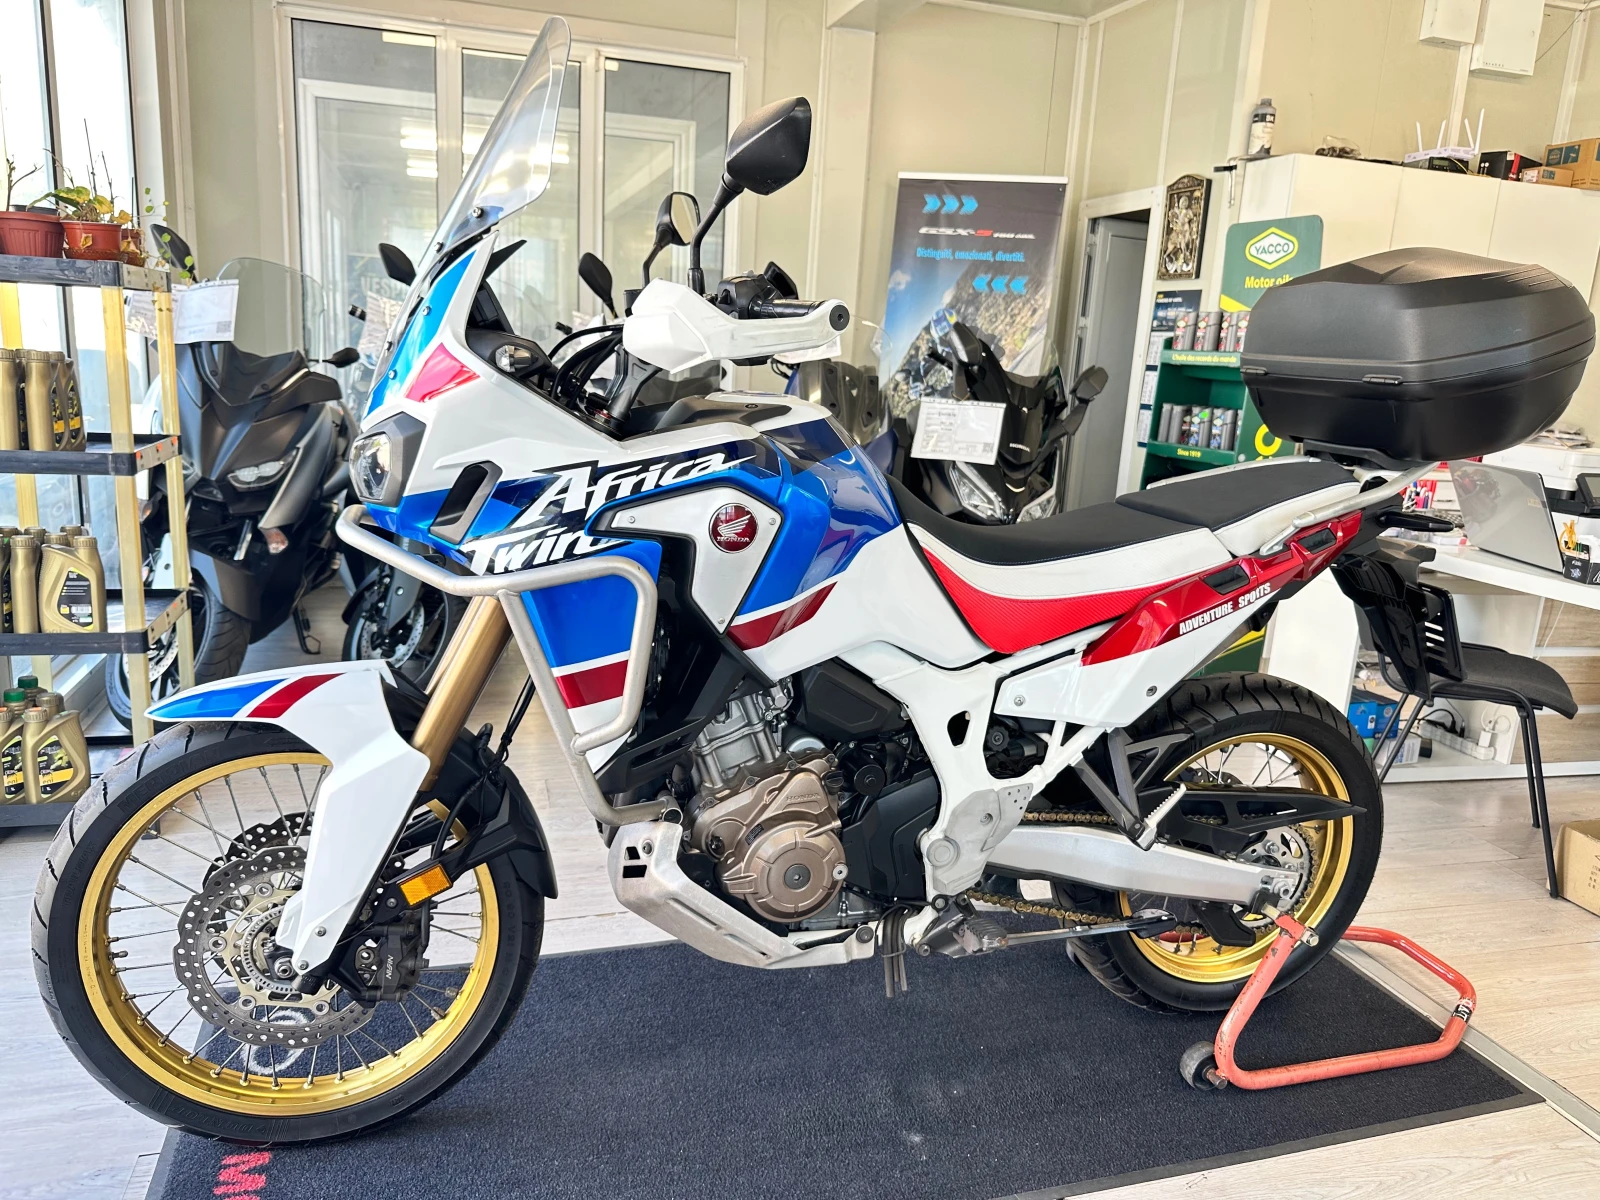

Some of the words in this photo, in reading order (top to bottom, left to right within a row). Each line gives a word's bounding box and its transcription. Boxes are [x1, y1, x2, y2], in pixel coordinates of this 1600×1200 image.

[916, 247, 953, 260] Distinguiti,
[955, 250, 994, 262] emozionati,
[995, 250, 1025, 263] divertiti.
[1254, 242, 1291, 256] YACCO
[1245, 276, 1275, 288] Motor
[1177, 448, 1189, 457] Since
[510, 453, 757, 529] Africa
[458, 523, 627, 577] Twin
[1179, 601, 1234, 635] ADVENTURE
[786, 792, 821, 802] HONDA
